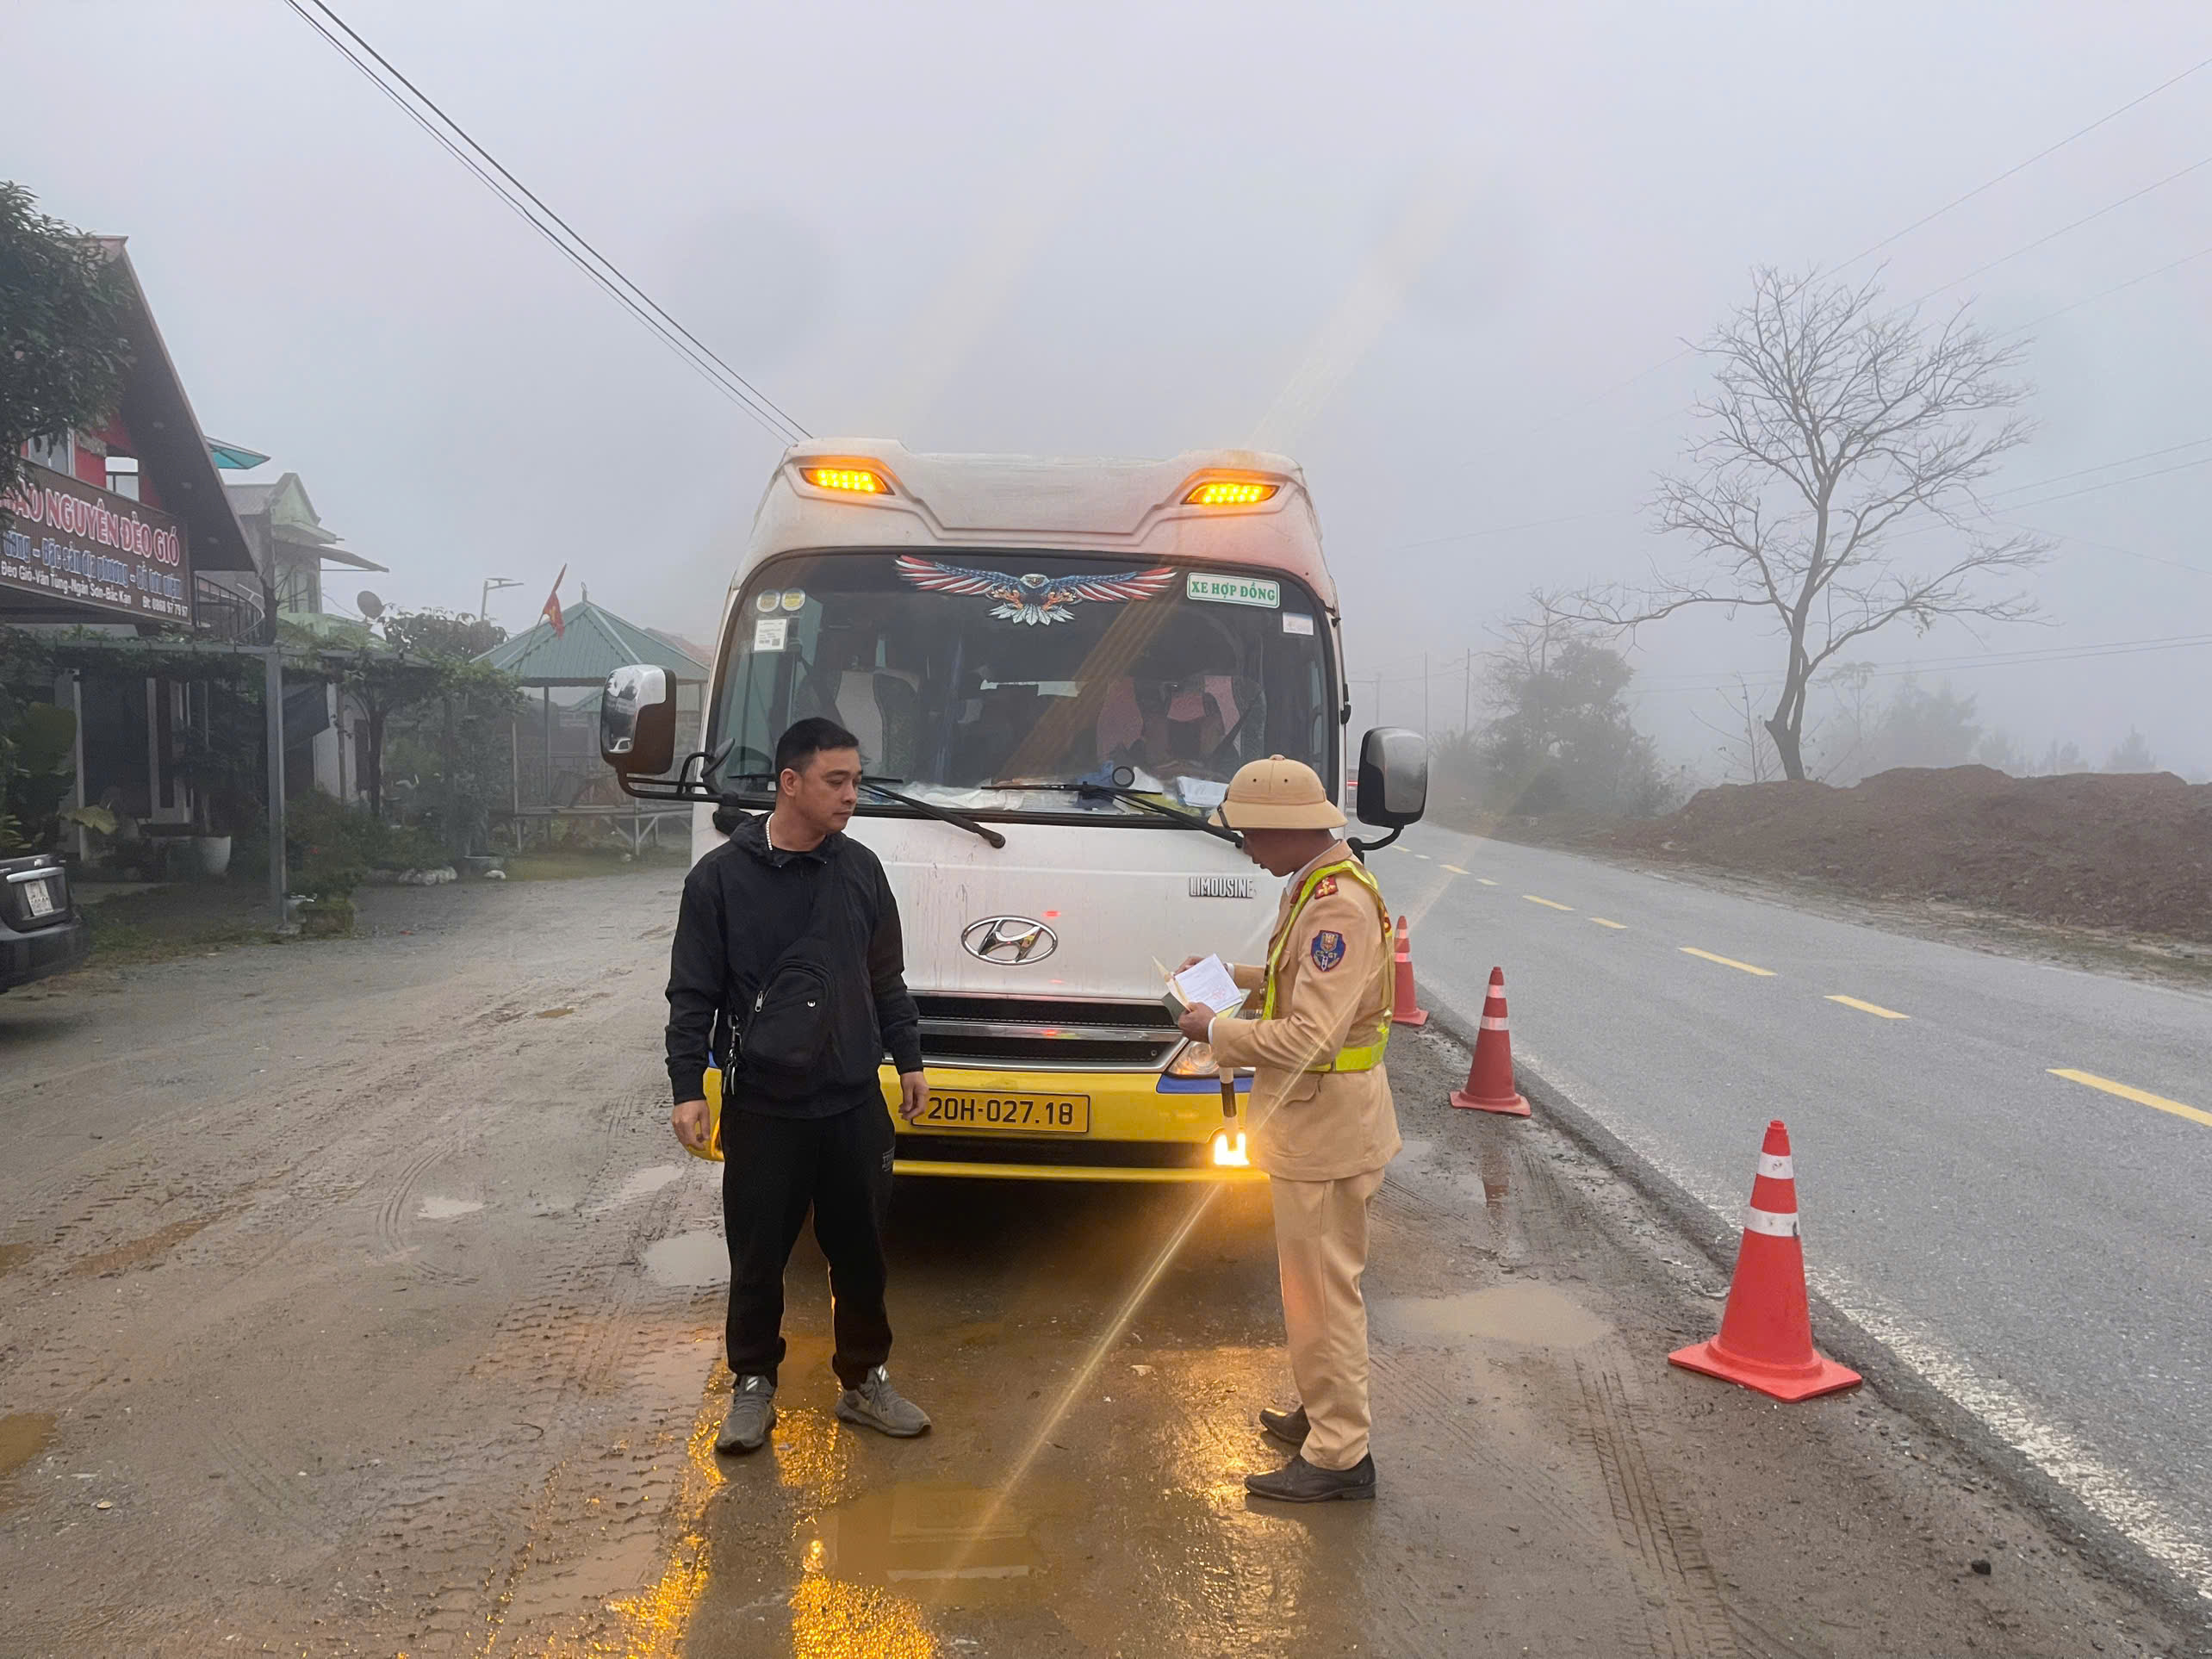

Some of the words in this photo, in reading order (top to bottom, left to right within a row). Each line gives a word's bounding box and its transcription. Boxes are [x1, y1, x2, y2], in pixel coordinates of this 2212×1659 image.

[46, 488, 120, 548] NGUYÊN
[121, 511, 152, 558] ĐÈO
[153, 526, 180, 566] GIÓ
[1191, 581, 1209, 593] XE
[1211, 582, 1237, 599] HỢP
[1240, 581, 1276, 601] ĐỒNG
[1189, 877, 1253, 899] LIMOUSINE
[928, 1097, 1073, 1125] 20H-027.18
